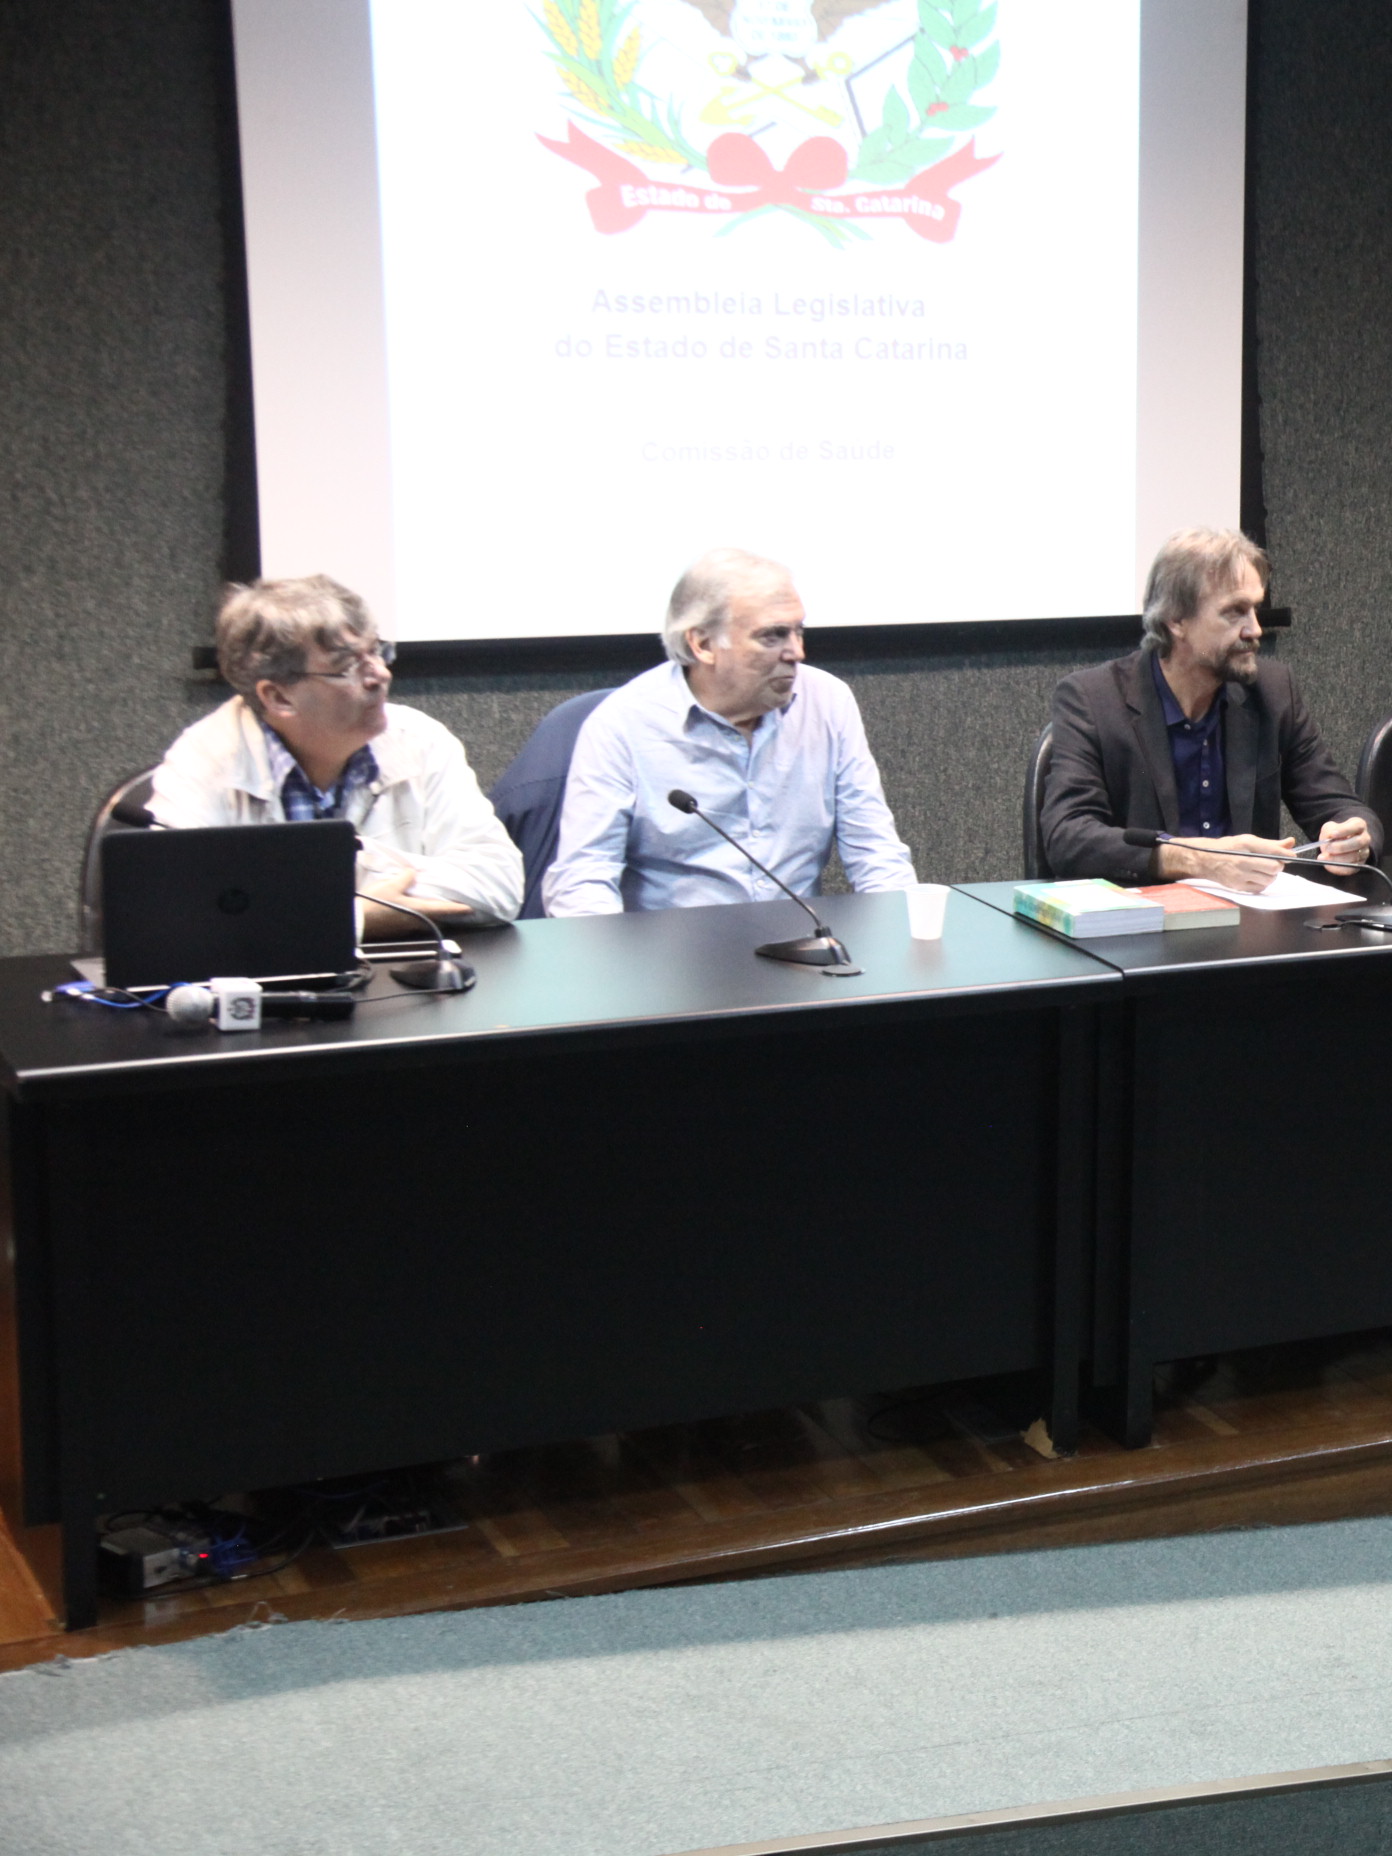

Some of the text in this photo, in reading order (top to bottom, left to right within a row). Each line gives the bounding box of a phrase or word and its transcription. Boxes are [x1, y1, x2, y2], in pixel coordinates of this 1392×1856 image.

[619, 185, 700, 208] Estado
[854, 196, 946, 221] Catarina
[590, 288, 927, 322] Assembleia Legislativa
[553, 334, 969, 361] do Estado de Santa Catarina
[640, 438, 896, 462] Comissão de Saúde
